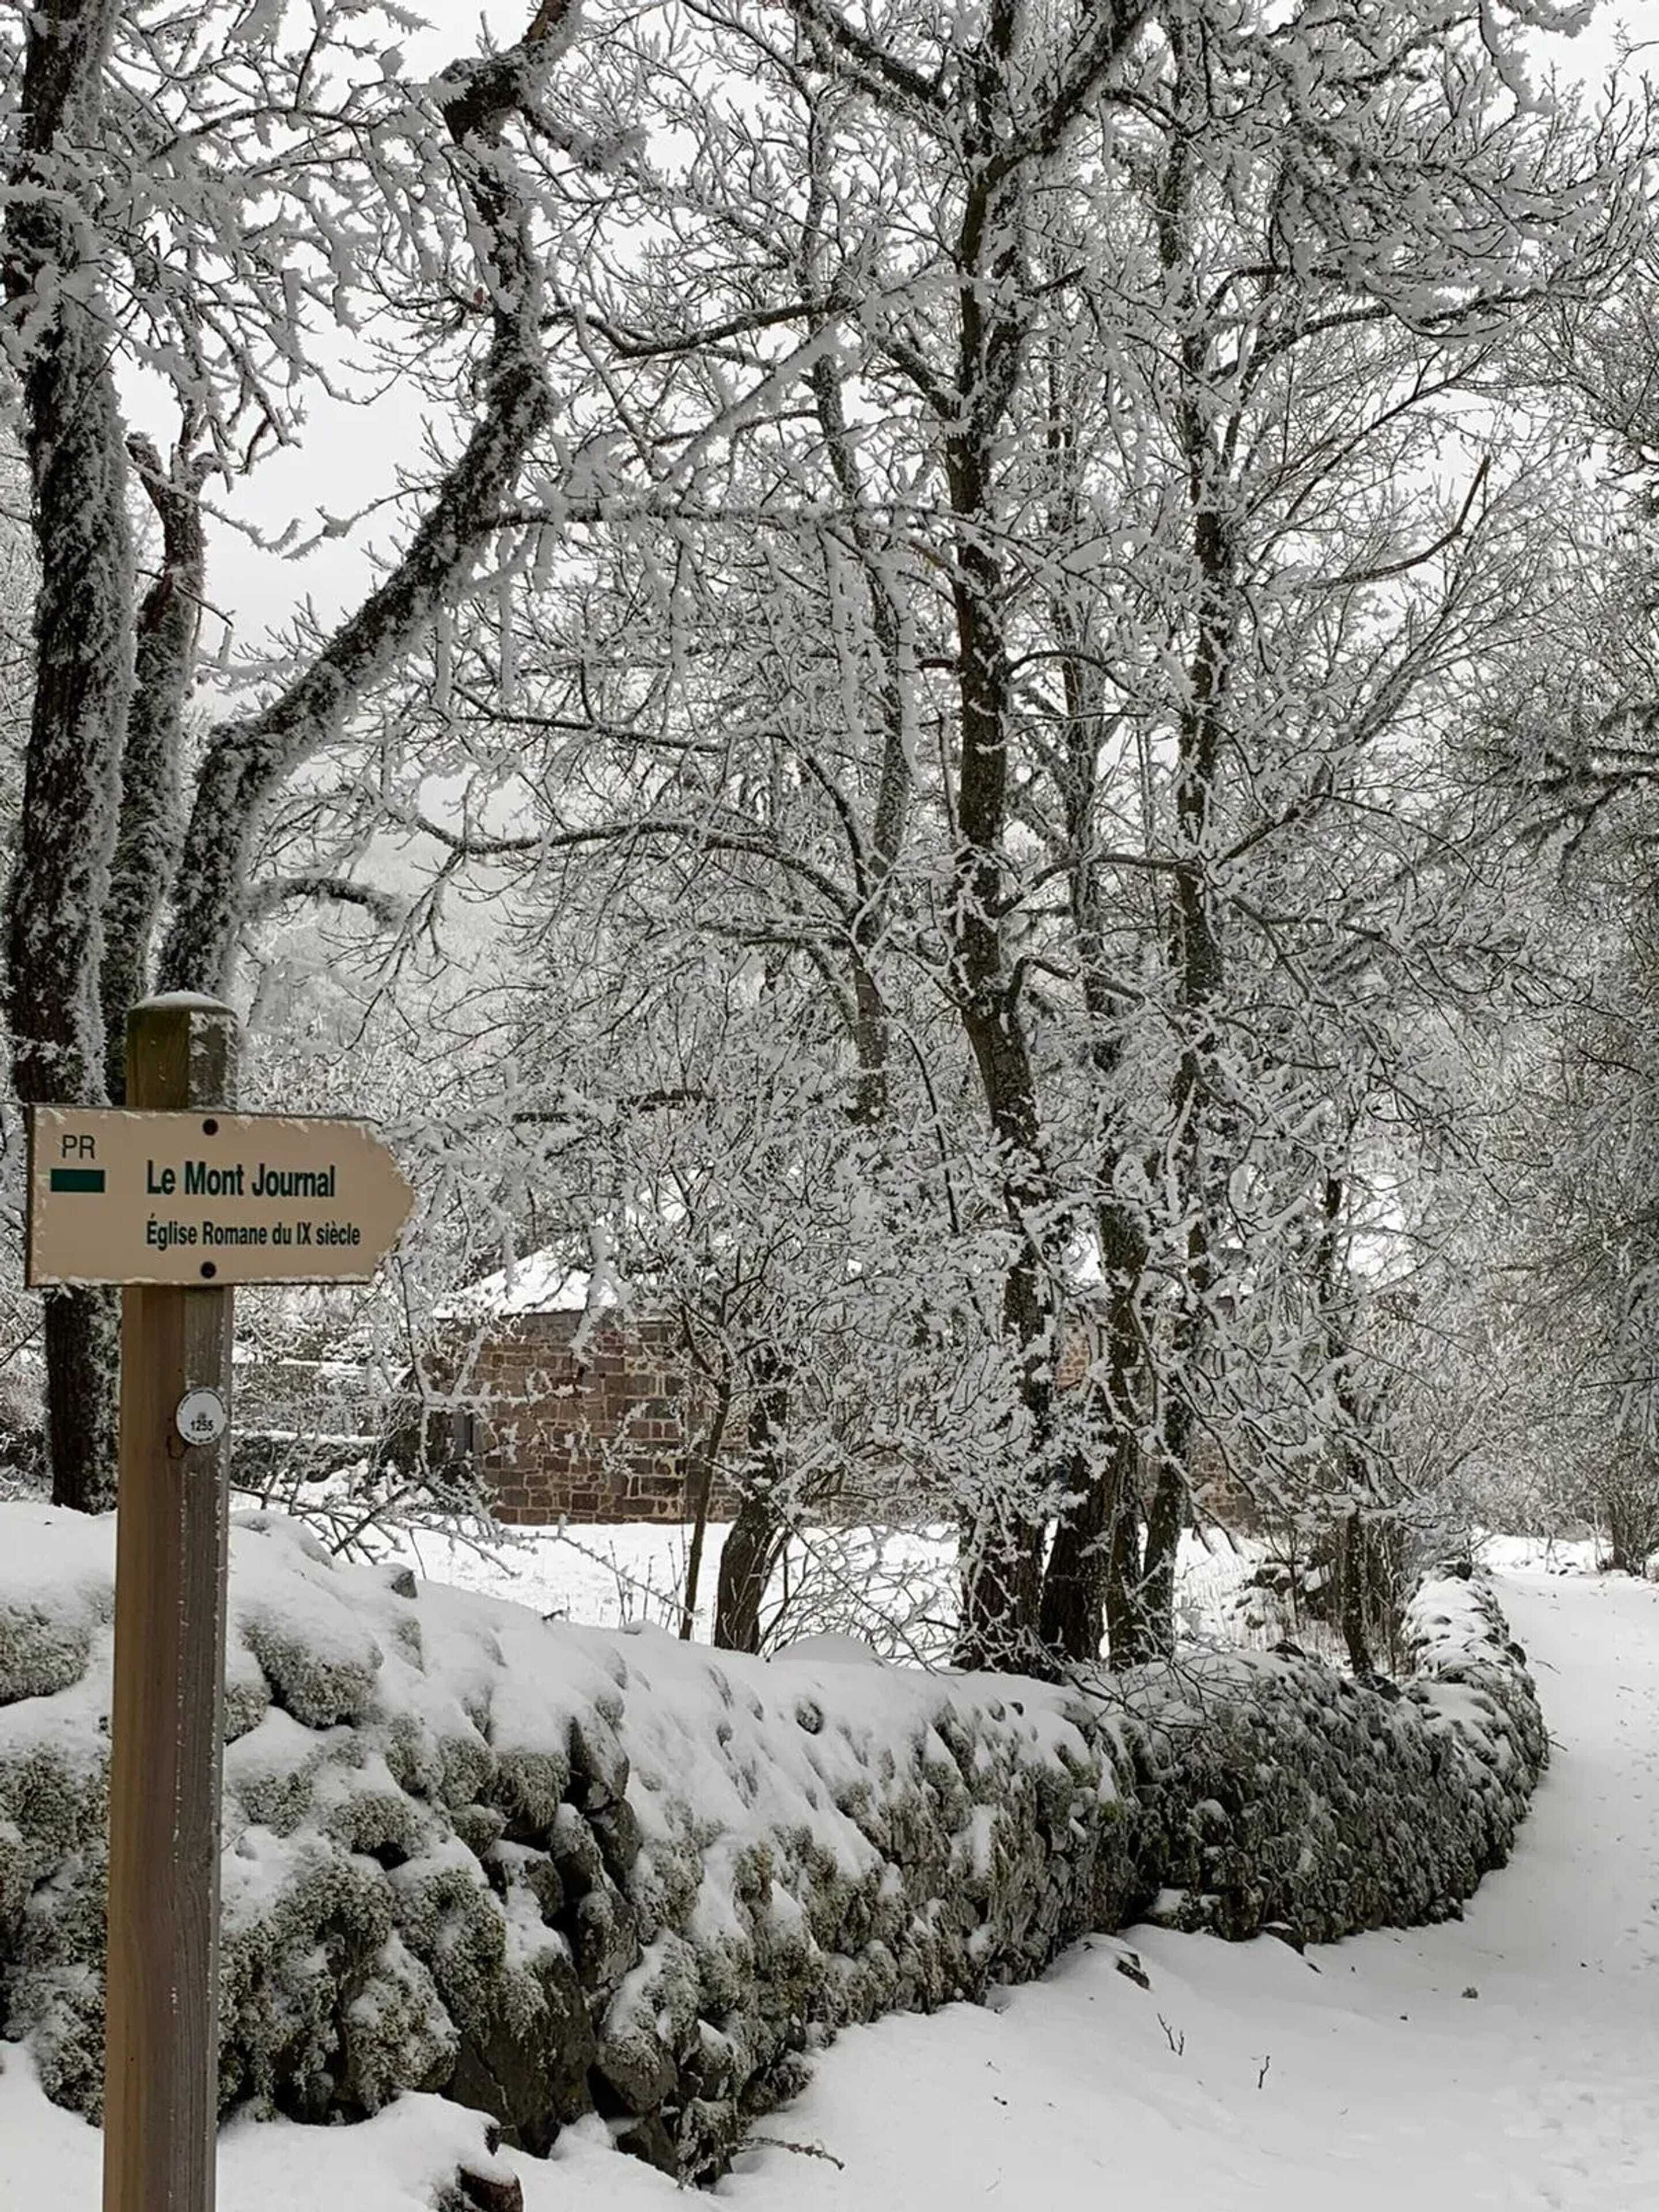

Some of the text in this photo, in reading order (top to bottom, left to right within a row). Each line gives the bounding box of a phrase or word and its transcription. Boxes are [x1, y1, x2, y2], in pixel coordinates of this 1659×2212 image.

[62, 1134, 96, 1160] PR
[147, 1160, 335, 1198] Le Mont Journal
[146, 1213, 361, 1250] Église Romane du IX siècle
